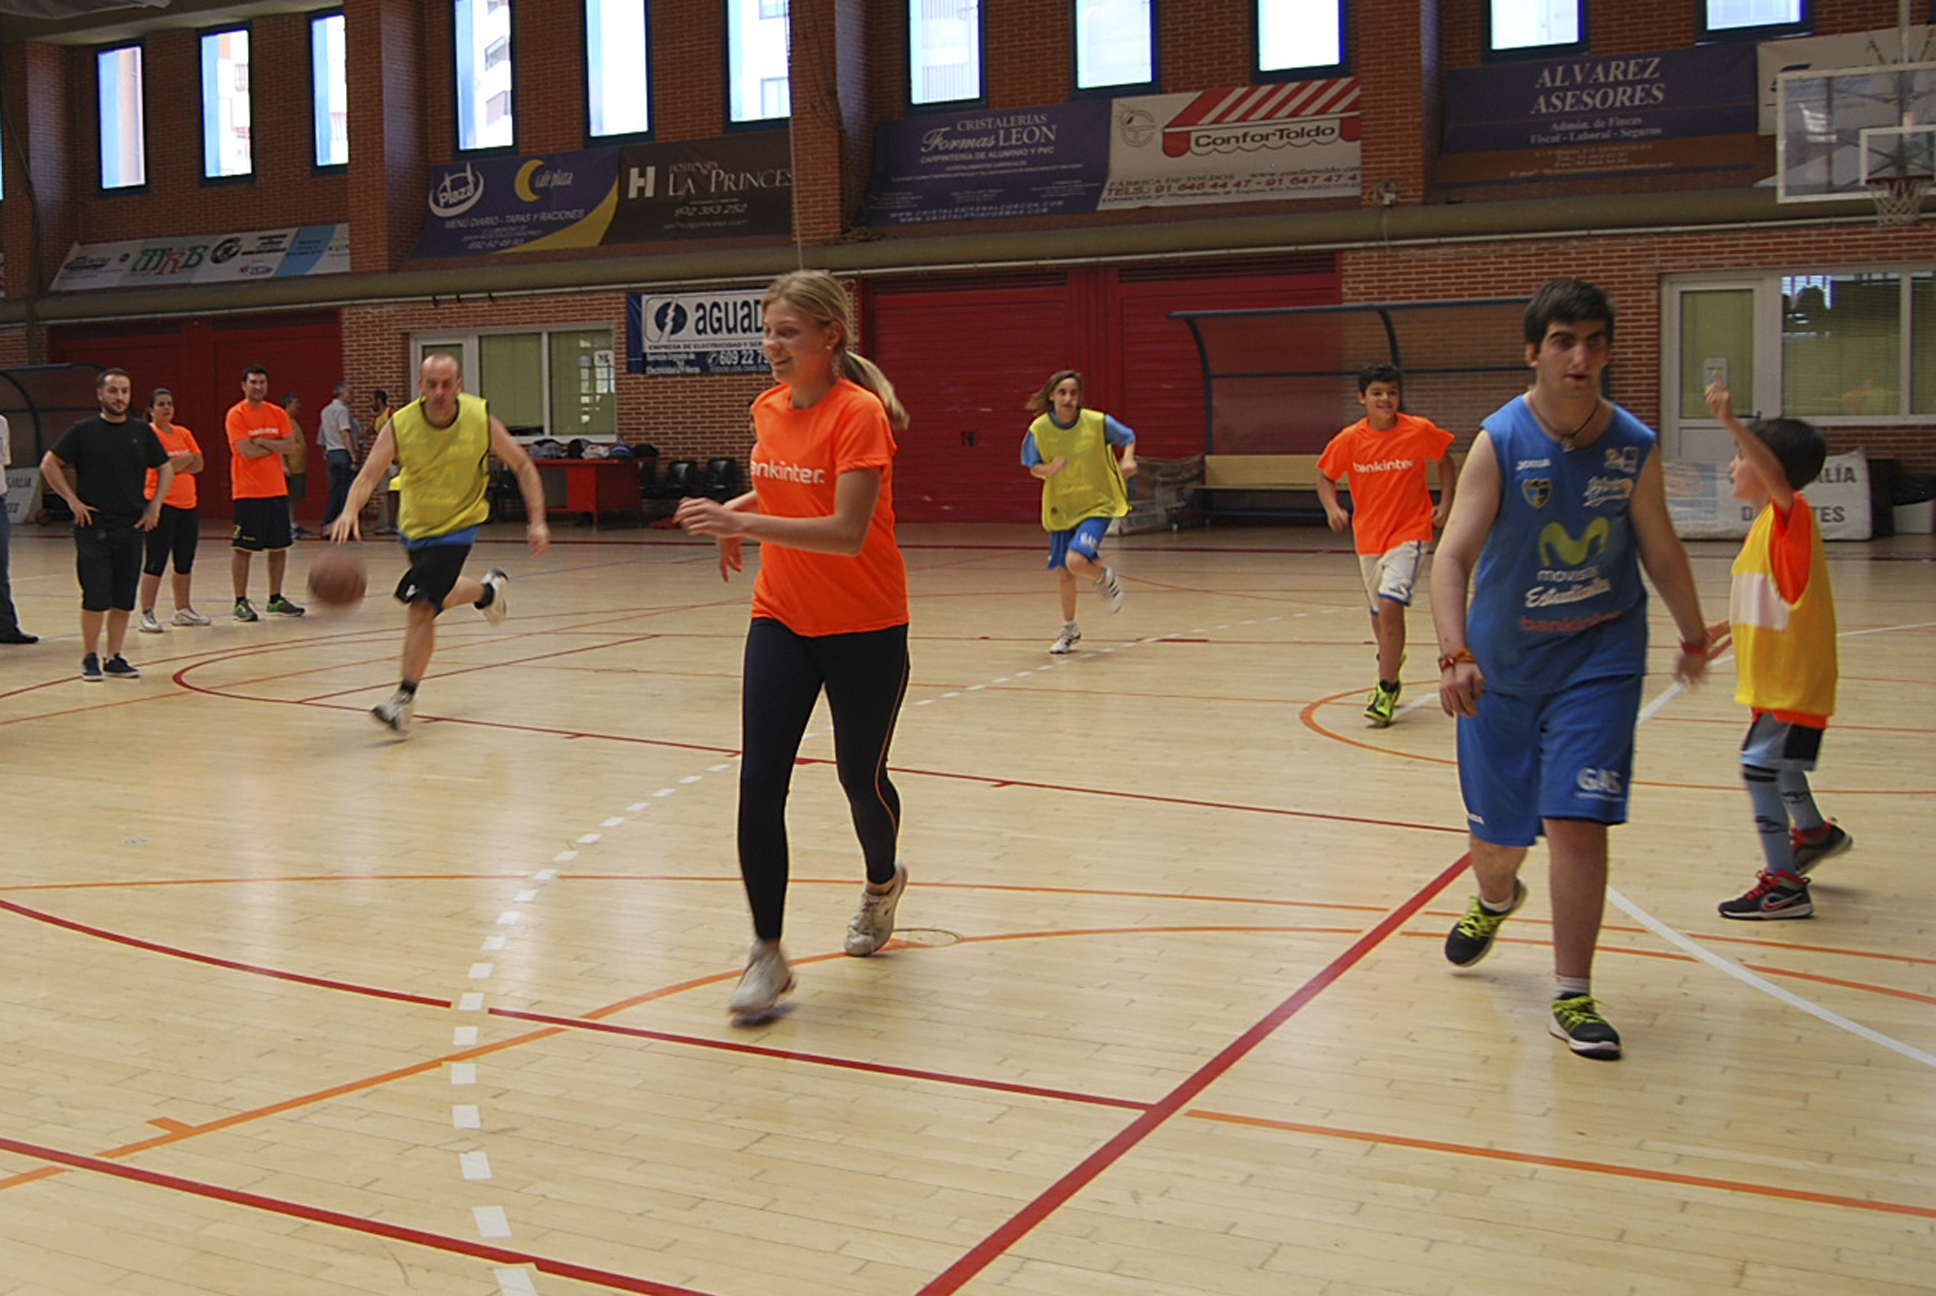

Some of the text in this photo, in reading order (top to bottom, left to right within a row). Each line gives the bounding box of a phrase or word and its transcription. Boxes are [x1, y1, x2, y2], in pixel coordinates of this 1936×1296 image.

[1534, 57, 1661, 88] ALVAREZ
[1530, 83, 1665, 114] ASESORES
[957, 113, 1048, 132] CRISTALERIAS
[998, 125, 1057, 147] LEON
[1195, 126, 1335, 147] ConforToldo
[628, 166, 656, 198] H
